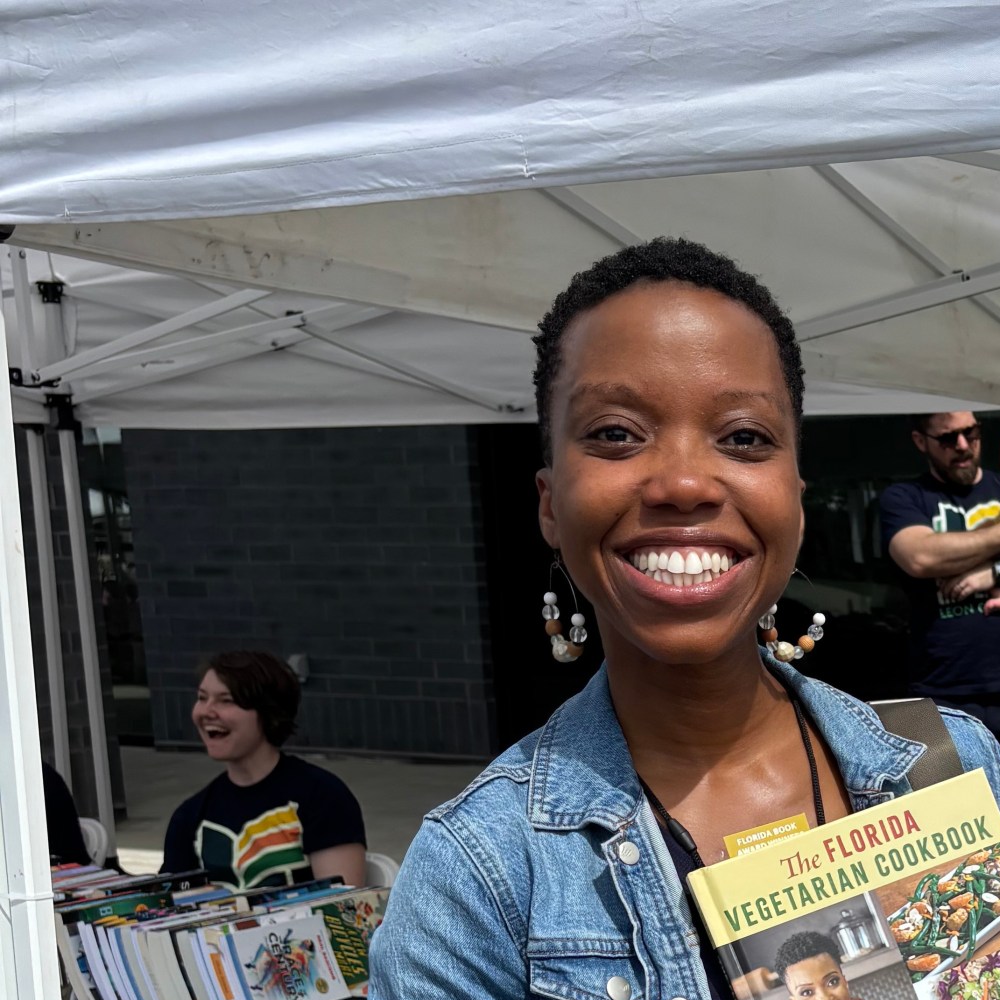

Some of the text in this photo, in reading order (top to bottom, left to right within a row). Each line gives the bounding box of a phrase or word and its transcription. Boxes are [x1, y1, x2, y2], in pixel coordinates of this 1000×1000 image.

[736, 822, 797, 846] FLORIDA BOOK
[780, 810, 920, 880] The FLORIDA
[724, 815, 993, 932] VEGETARIAN COOKBOOK
